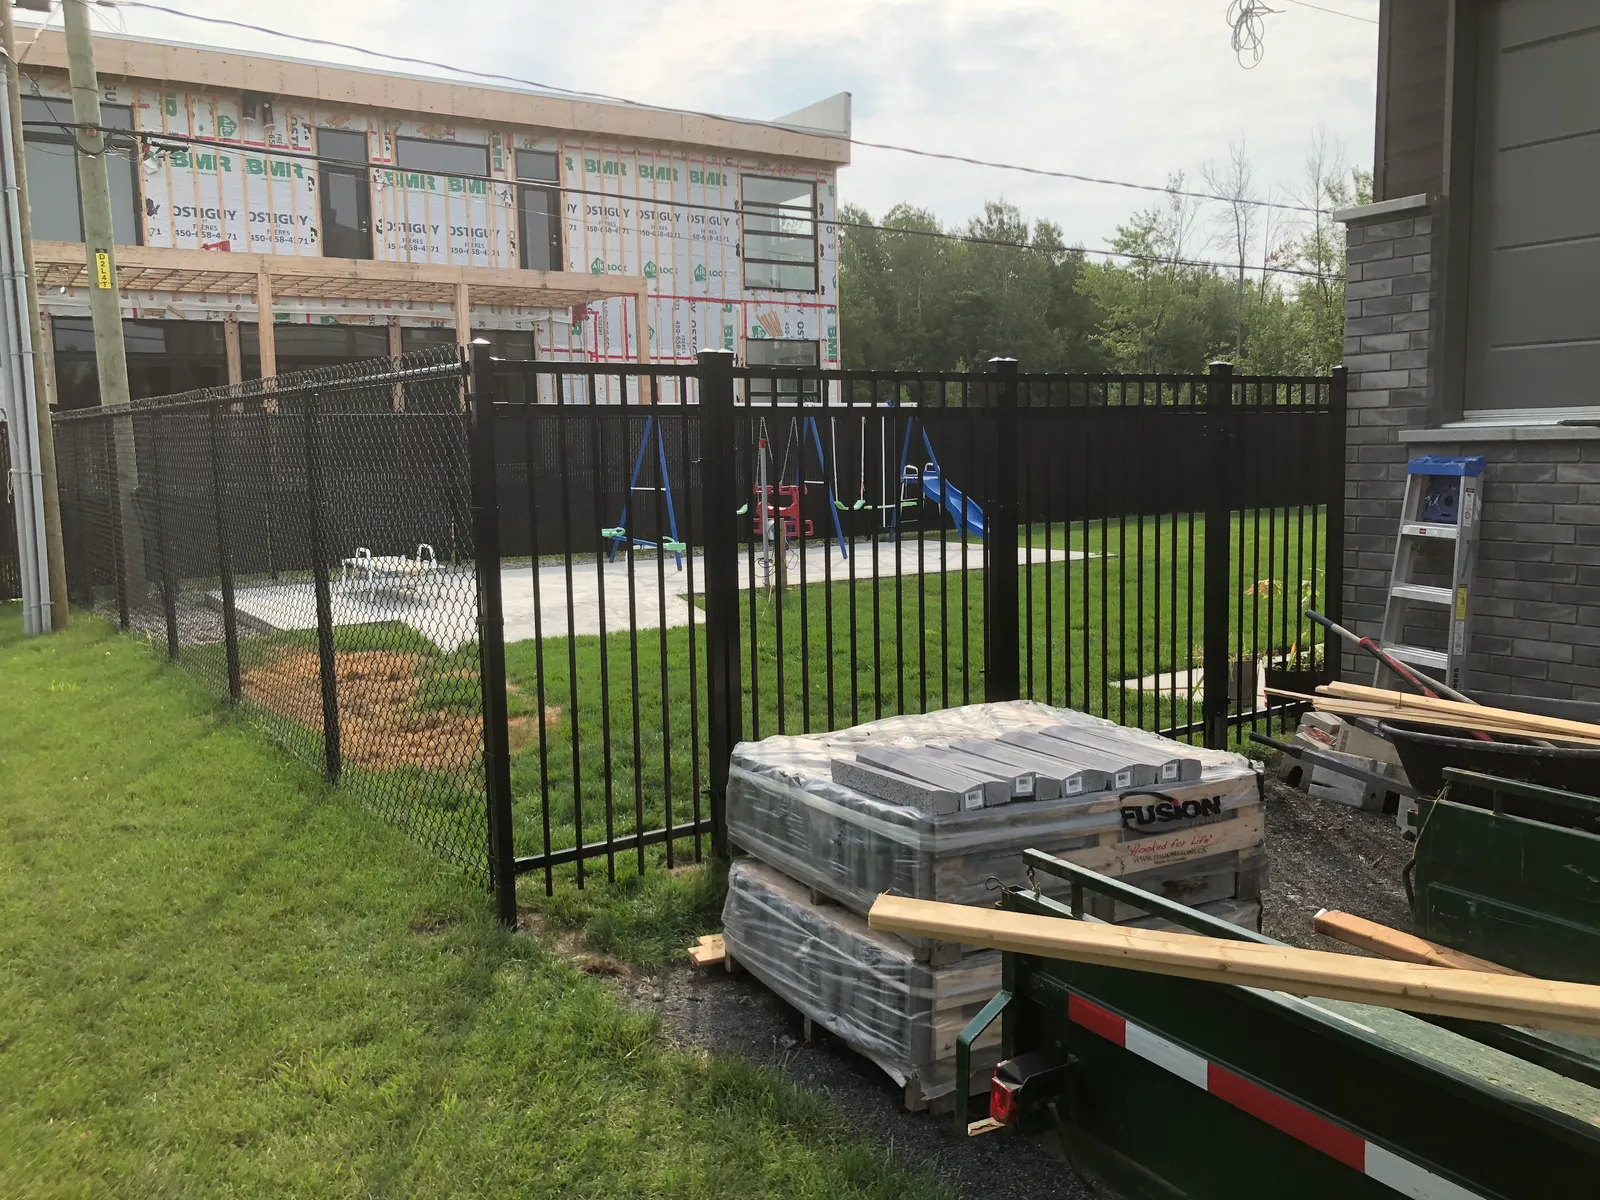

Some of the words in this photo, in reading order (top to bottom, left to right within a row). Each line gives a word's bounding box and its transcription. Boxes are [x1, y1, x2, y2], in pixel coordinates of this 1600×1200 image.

[170, 152, 232, 172] BMR
[246, 159, 304, 179] BMR
[585, 159, 627, 176] BMR
[384, 171, 436, 190] BMR
[638, 165, 679, 181] BMR
[690, 170, 728, 186] BMR
[173, 205, 237, 221] OSTIGUY
[99, 253, 108, 288] D2L4T
[1120, 795, 1222, 825] FUSION
[1171, 839, 1186, 848] for
